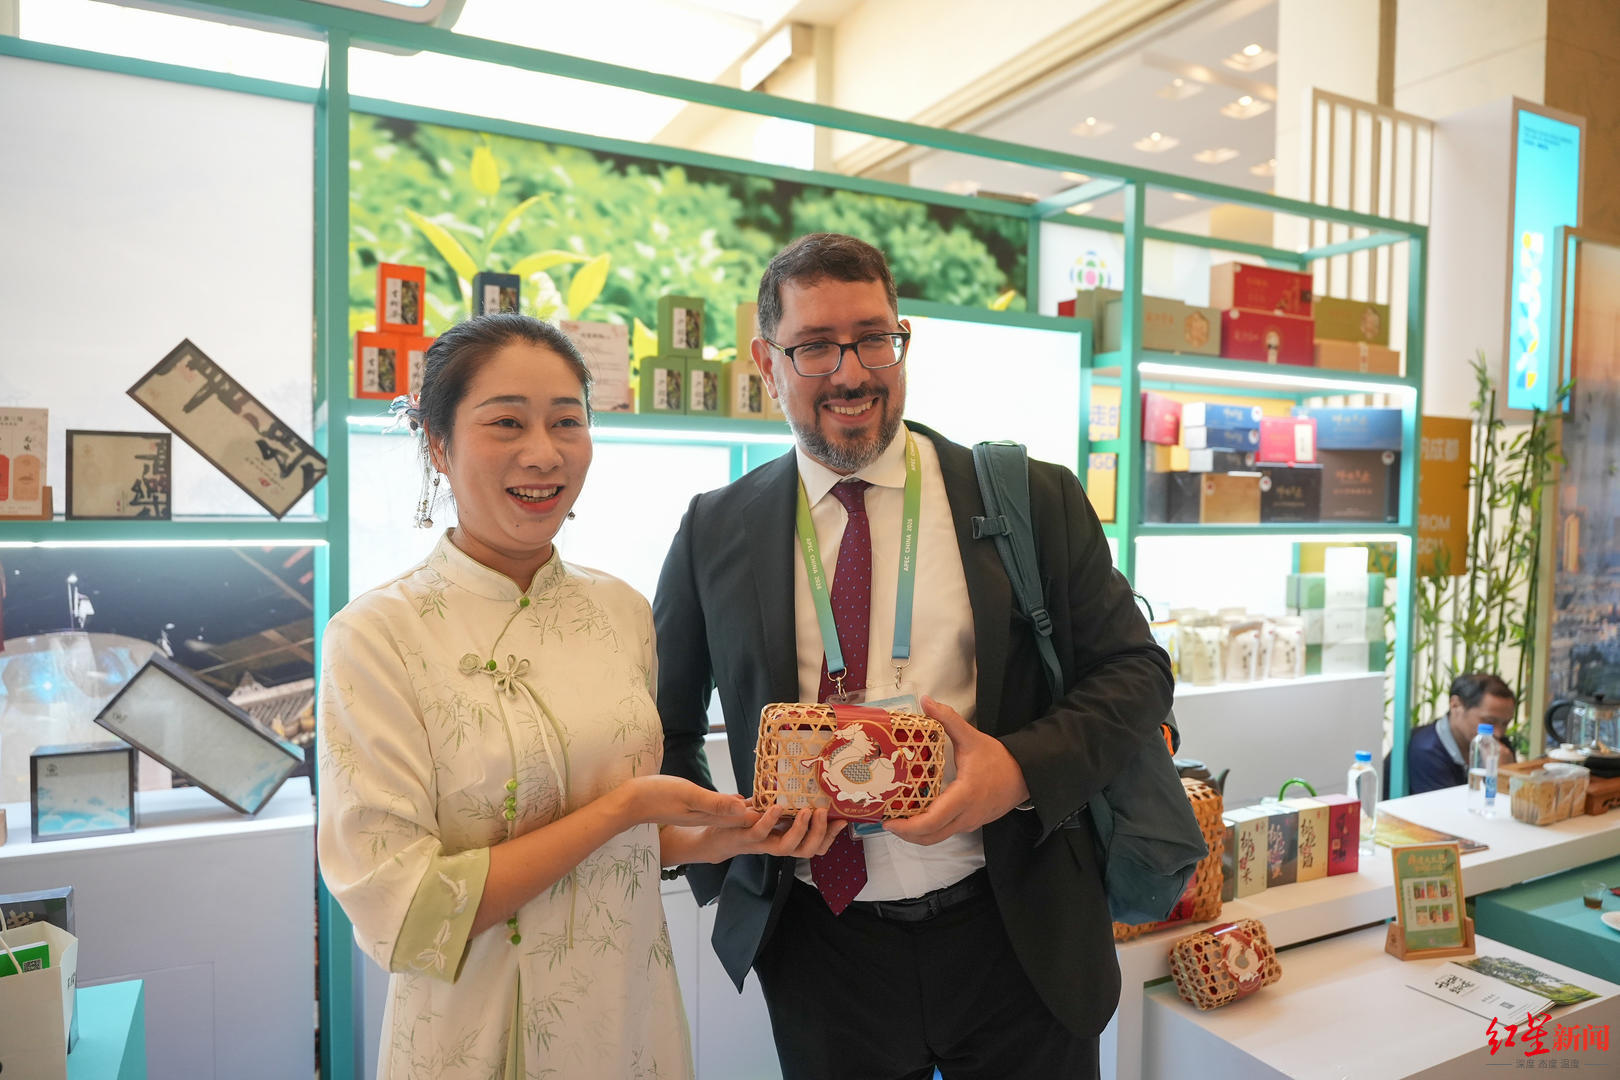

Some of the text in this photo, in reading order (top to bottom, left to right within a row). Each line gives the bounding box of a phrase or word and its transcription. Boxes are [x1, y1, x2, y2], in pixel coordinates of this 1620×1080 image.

[806, 537, 815, 553] APEC
[904, 534, 913, 554] CHINA
[810, 554, 818, 574] CHINA
[903, 555, 911, 572] APEC
